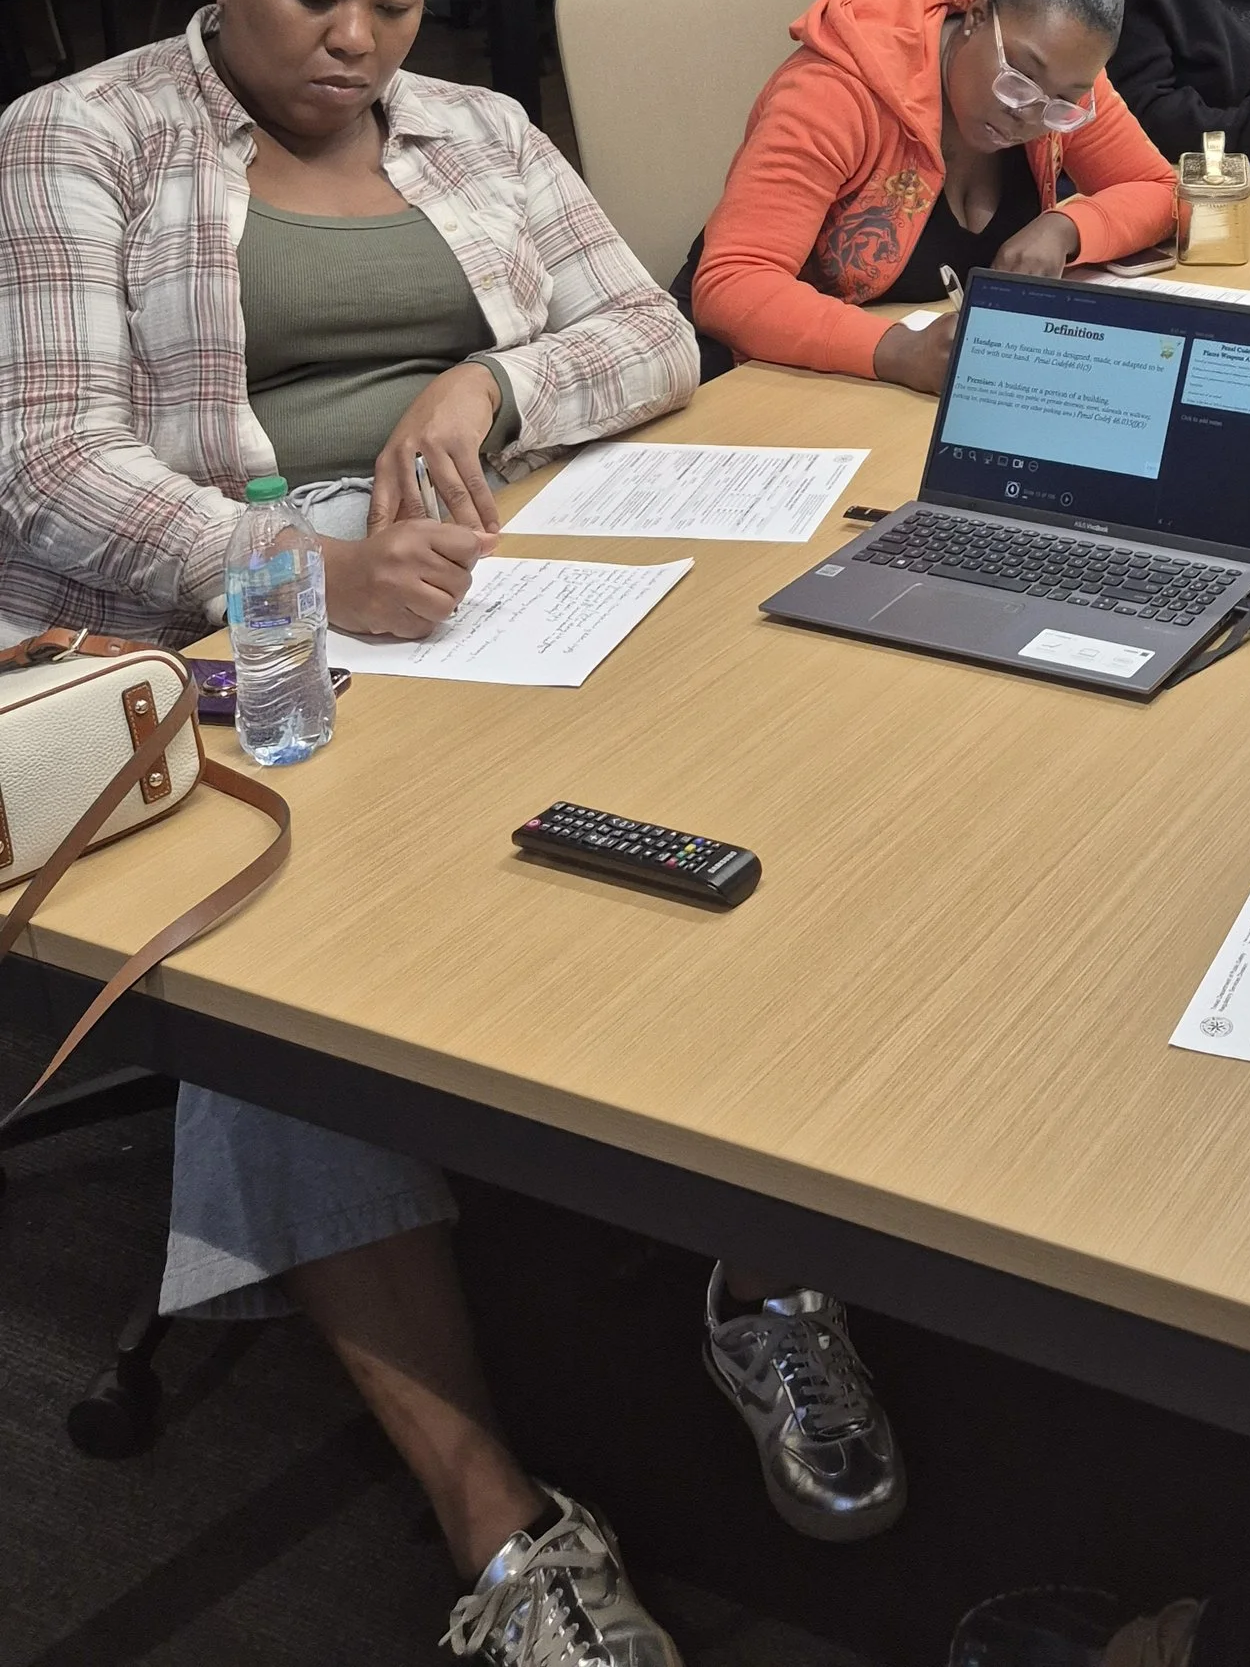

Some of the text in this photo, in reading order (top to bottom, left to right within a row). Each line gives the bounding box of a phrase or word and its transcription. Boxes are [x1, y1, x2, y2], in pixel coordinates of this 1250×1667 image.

[1042, 321, 1106, 342] Definitions
[985, 348, 1000, 358] with
[1120, 358, 1148, 371] adapted
[1003, 381, 1031, 394] building
[1042, 386, 1069, 399] portion
[707, 850, 738, 874] SAMSUNG
[1215, 977, 1233, 998] Department
